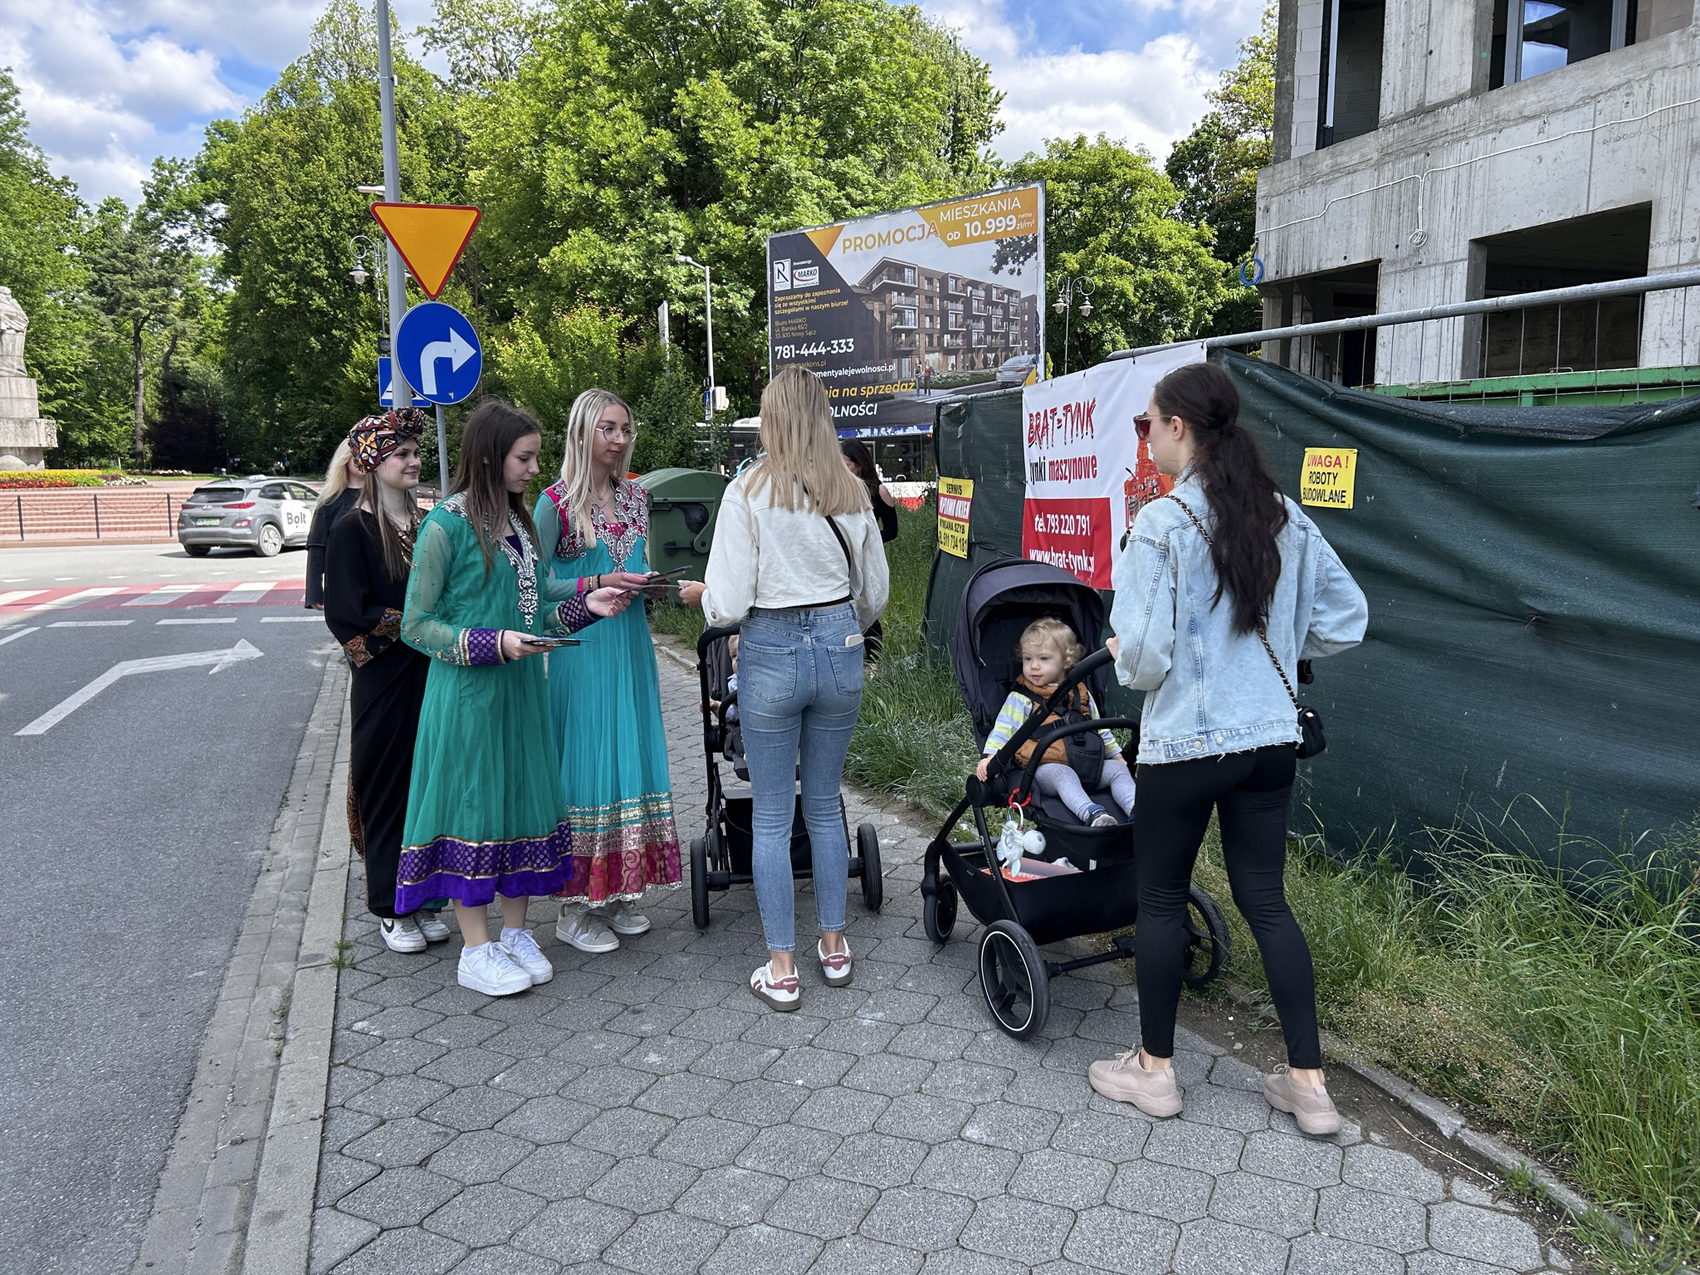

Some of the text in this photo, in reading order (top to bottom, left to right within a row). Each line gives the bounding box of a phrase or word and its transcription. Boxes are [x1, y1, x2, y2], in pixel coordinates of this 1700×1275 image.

[939, 197, 1022, 223] MIESZKANIA
[946, 231, 961, 242] OD
[963, 214, 1017, 238] 10.999
[842, 221, 940, 254] PROMOCJA
[798, 269, 817, 278] MARKO
[812, 288, 840, 297] zapoznania
[788, 298, 817, 307] wszystkimi
[811, 302, 830, 310] naszym
[774, 338, 855, 360] 781-444-333
[816, 362, 896, 379] mentyalejewolnosci.pl
[842, 386, 858, 398] na
[860, 379, 916, 399] sprzedaż
[1027, 397, 1096, 450] BRAT-TYNK
[1029, 455, 1098, 485] tynki maszynowe
[1307, 454, 1343, 469] UWAGA
[1308, 470, 1339, 486] ROBOTY
[945, 482, 963, 496] SERWIS
[1302, 486, 1347, 504] BUDOWLANE
[286, 511, 307, 525] Bolt
[1046, 514, 1060, 535] 793
[1060, 514, 1075, 536] 220
[1076, 514, 1091, 537] 791
[954, 522, 966, 535] SZYB
